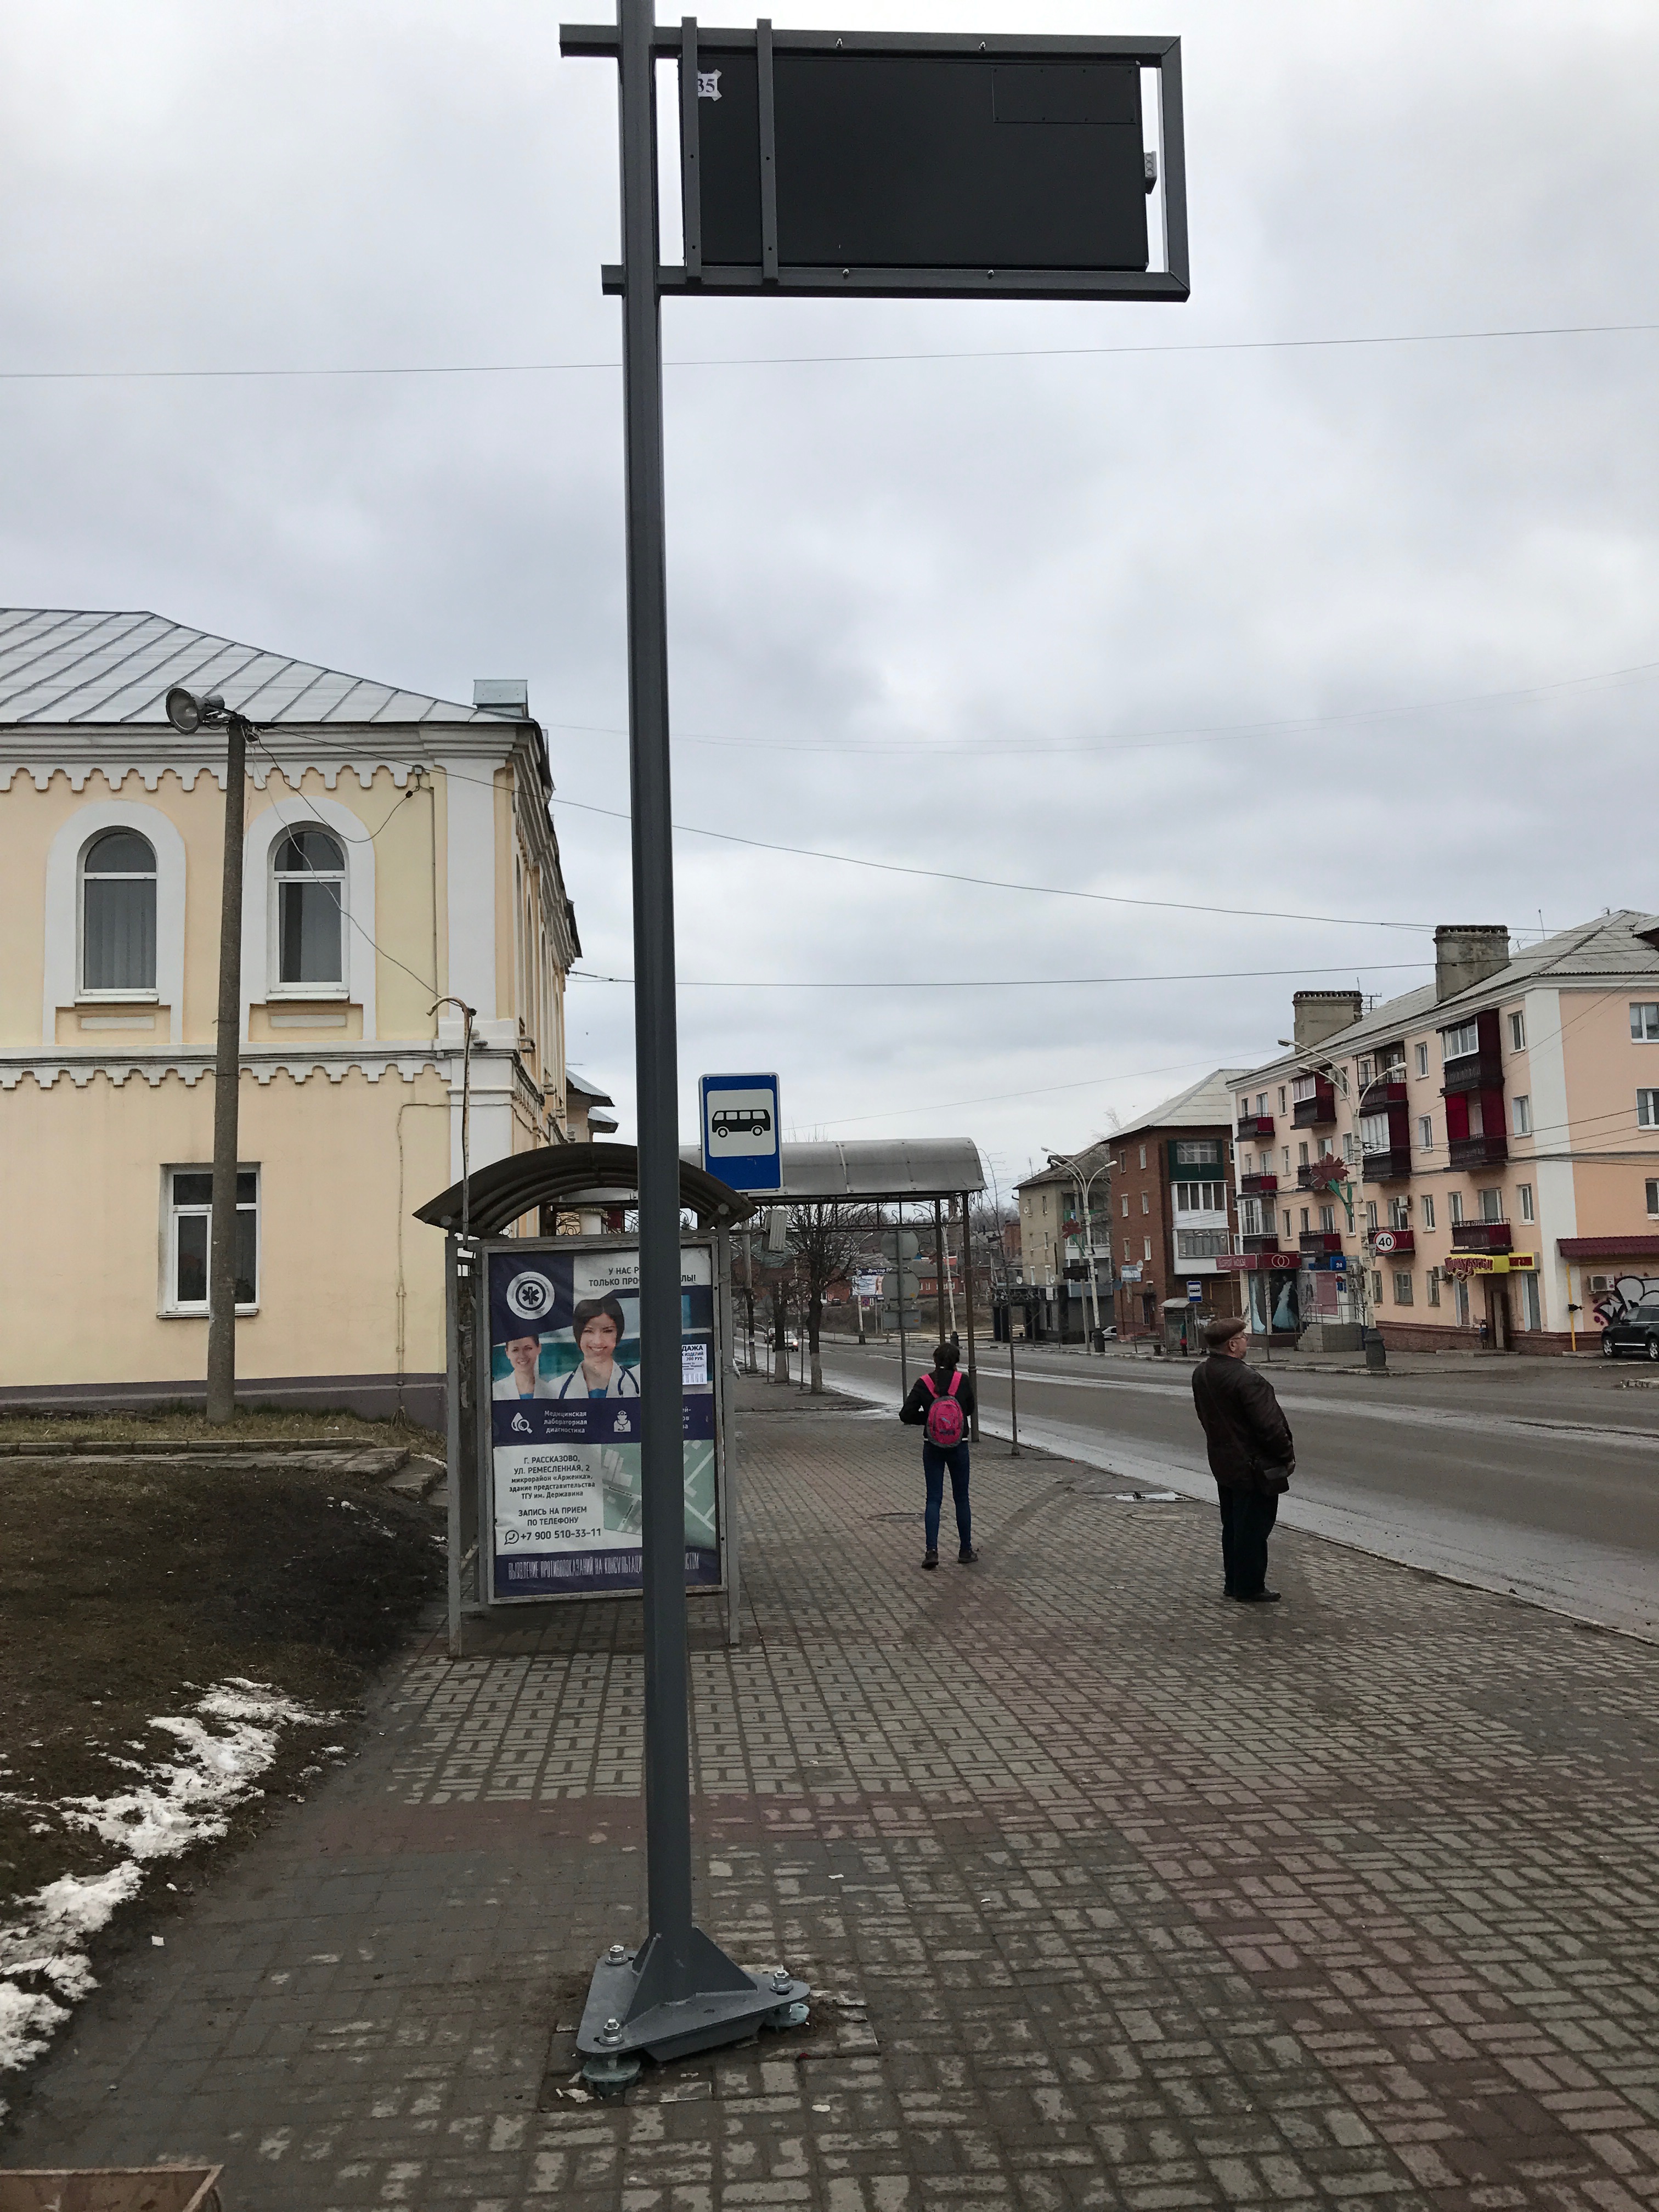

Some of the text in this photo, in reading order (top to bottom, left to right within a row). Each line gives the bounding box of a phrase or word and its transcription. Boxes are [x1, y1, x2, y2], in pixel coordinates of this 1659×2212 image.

[1378, 1237, 1392, 1247] 40
[616, 1267, 631, 1275] НАС
[589, 1278, 620, 1287] ТОЛЬКО
[544, 1418, 588, 1426] лабораторная
[532, 1455, 580, 1464] РАССКАЗОВО,
[528, 1465, 583, 1474] РЕМЕСЛЕННАЯ,
[511, 1475, 551, 1483] микрорайон
[533, 1482, 595, 1491] представительства
[546, 1491, 584, 1499] Державина
[518, 1509, 547, 1517] ЗАПИСЬ
[539, 1516, 579, 1525] ТЕЛЕФОНУ
[521, 1528, 601, 1541] +7 900 510-33-11
[509, 1552, 699, 1580] ВЫЯВЛЕНИЕ ПРОТИВОПОКАЗАНИЙ НА КОНСУЛЬТАЦИ СТОМ
